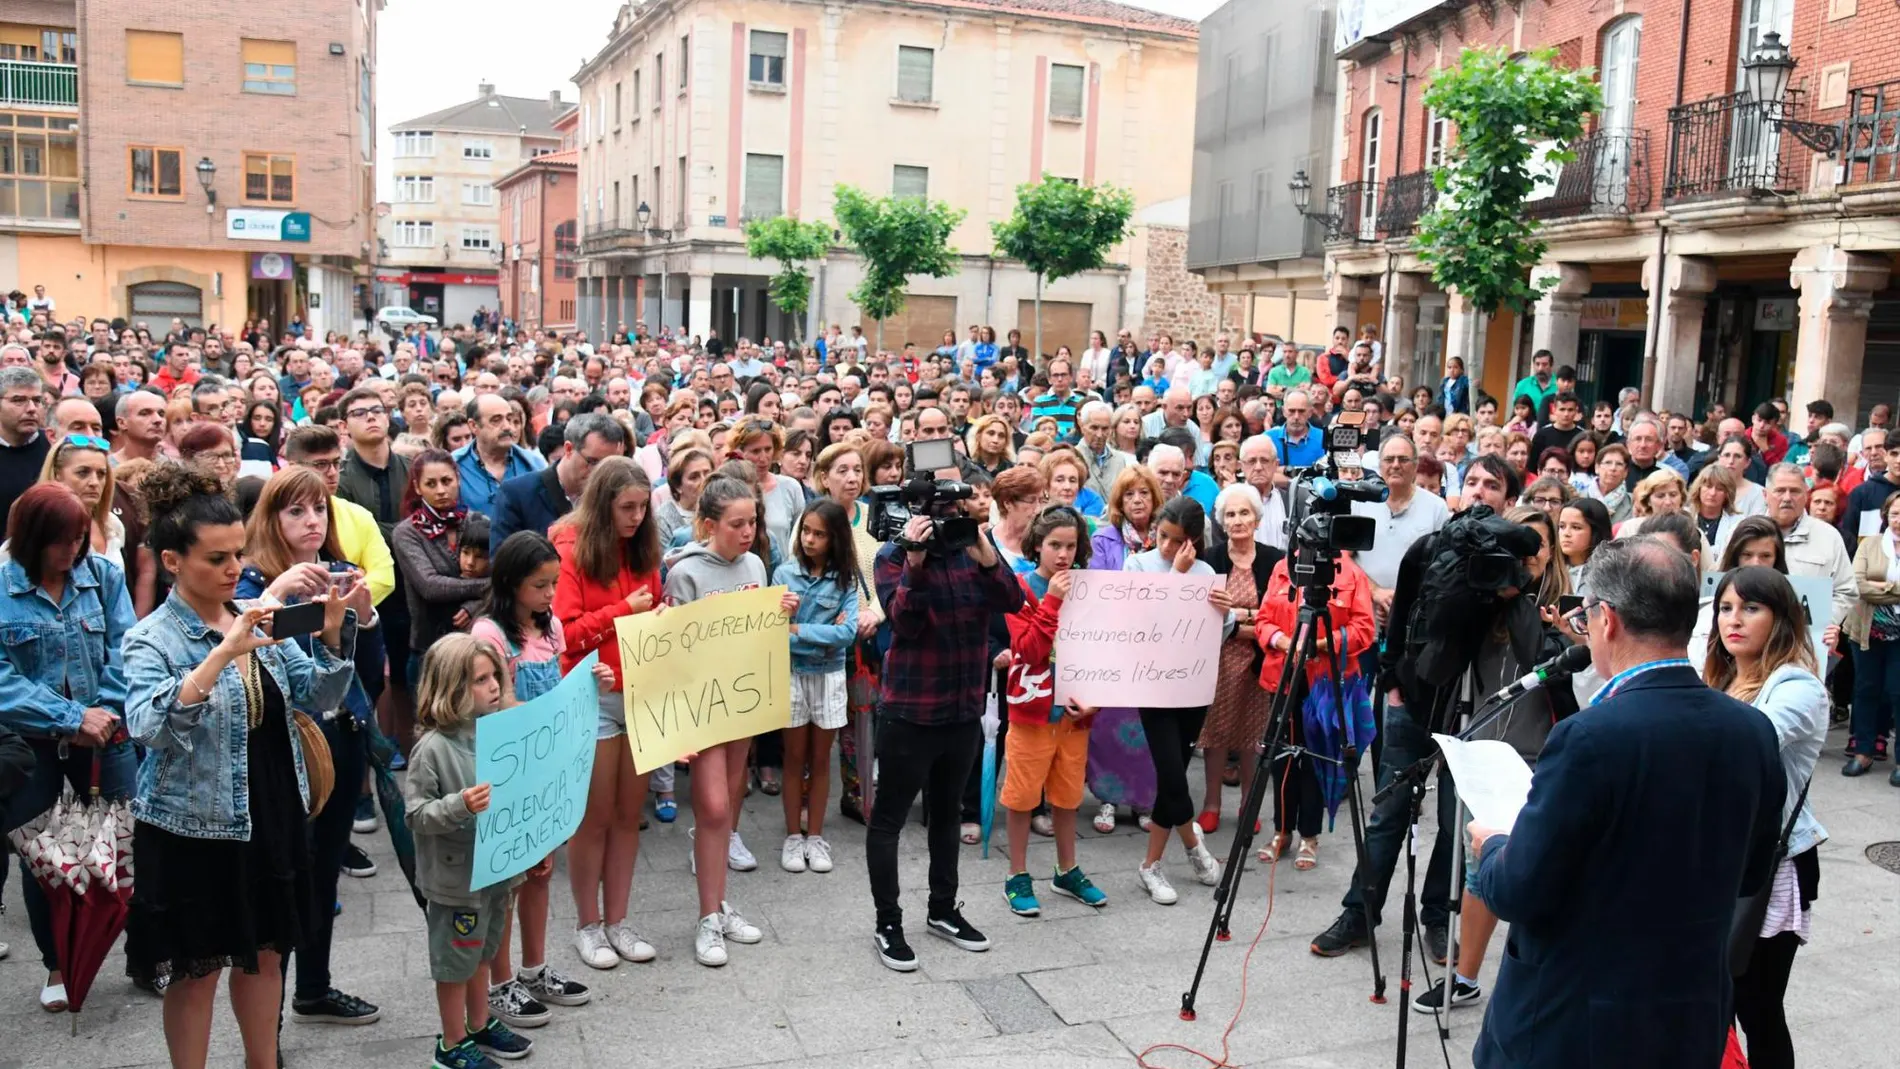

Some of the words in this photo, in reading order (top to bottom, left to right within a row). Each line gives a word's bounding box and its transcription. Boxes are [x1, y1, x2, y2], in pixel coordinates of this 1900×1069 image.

[1099, 580, 1169, 601] estás
[622, 630, 672, 669] NOS
[680, 611, 787, 652] QUEREMOS
[631, 651, 773, 753] ¡VIVAS!
[478, 770, 567, 843] VIOLENCIA
[572, 750, 590, 783] DE
[489, 798, 573, 874] GÉNERO
